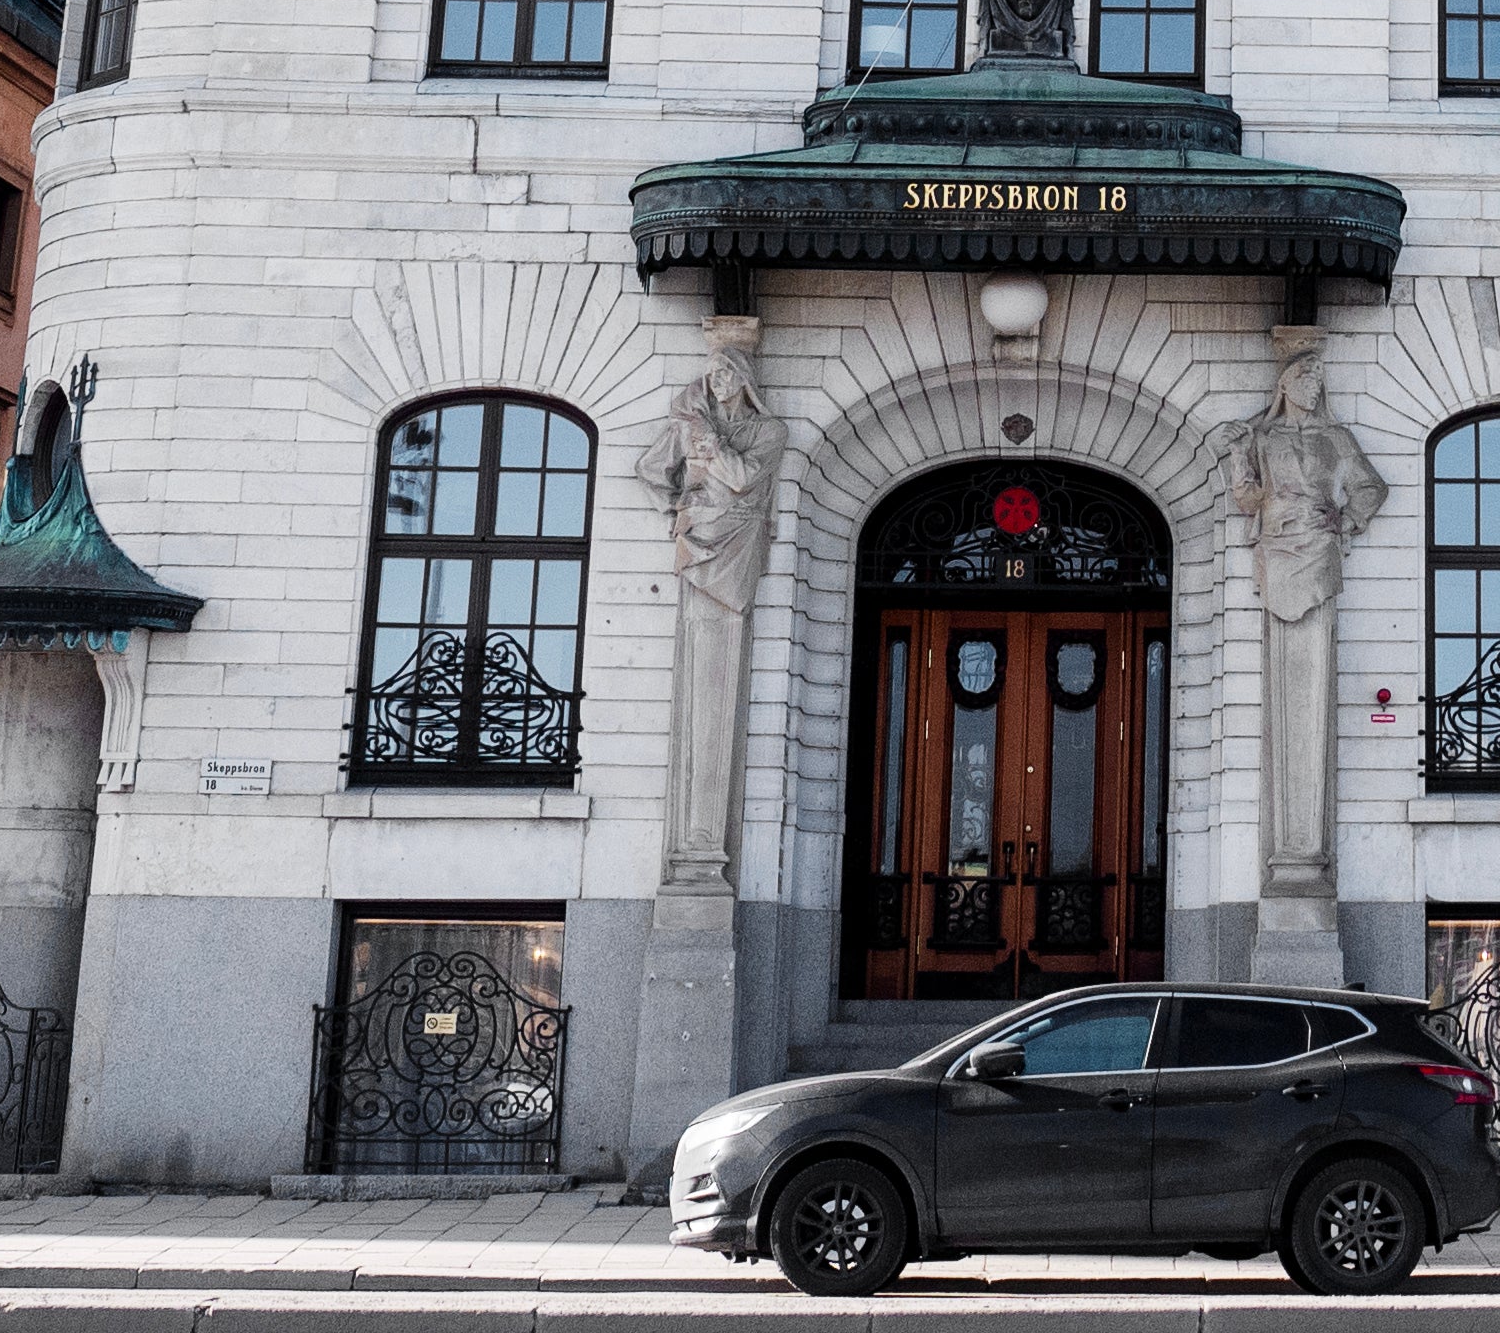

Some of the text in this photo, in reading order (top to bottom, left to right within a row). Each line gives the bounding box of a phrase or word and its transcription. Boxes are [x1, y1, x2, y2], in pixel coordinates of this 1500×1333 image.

[903, 183, 1127, 212] SKEPPSBRON 18
[1006, 559, 1025, 578] 18
[207, 761, 265, 776] Skeppsbron
[206, 779, 217, 791] 18
